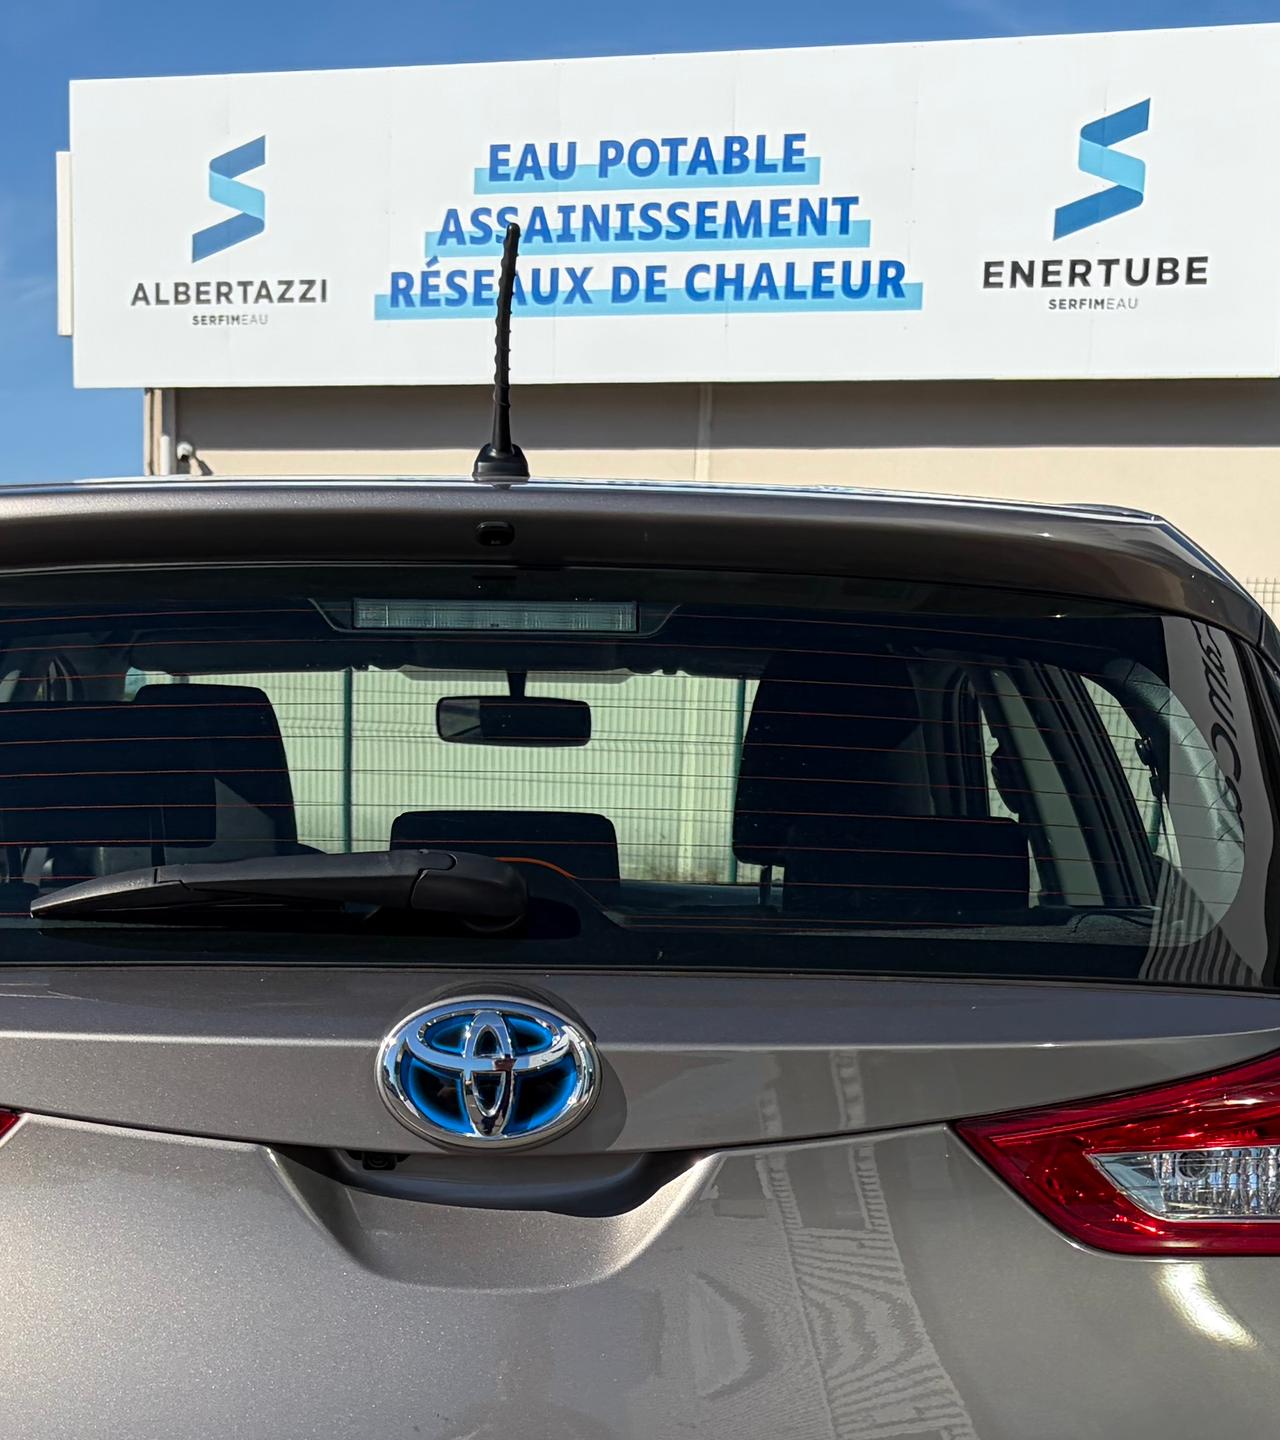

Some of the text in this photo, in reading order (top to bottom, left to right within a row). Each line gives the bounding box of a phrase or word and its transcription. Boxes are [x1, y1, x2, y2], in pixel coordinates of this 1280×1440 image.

[487, 132, 808, 182] EAU POTABLE
[437, 195, 860, 247] ASSAINISSEMENT
[611, 265, 668, 303] DE
[684, 259, 907, 302] CHALEUR
[982, 255, 1210, 289] ENERTUBE
[130, 278, 328, 307] ALBERTAZZI
[1048, 297, 1139, 311] SERFIMEAU
[191, 313, 269, 326] SERFIMEAU
